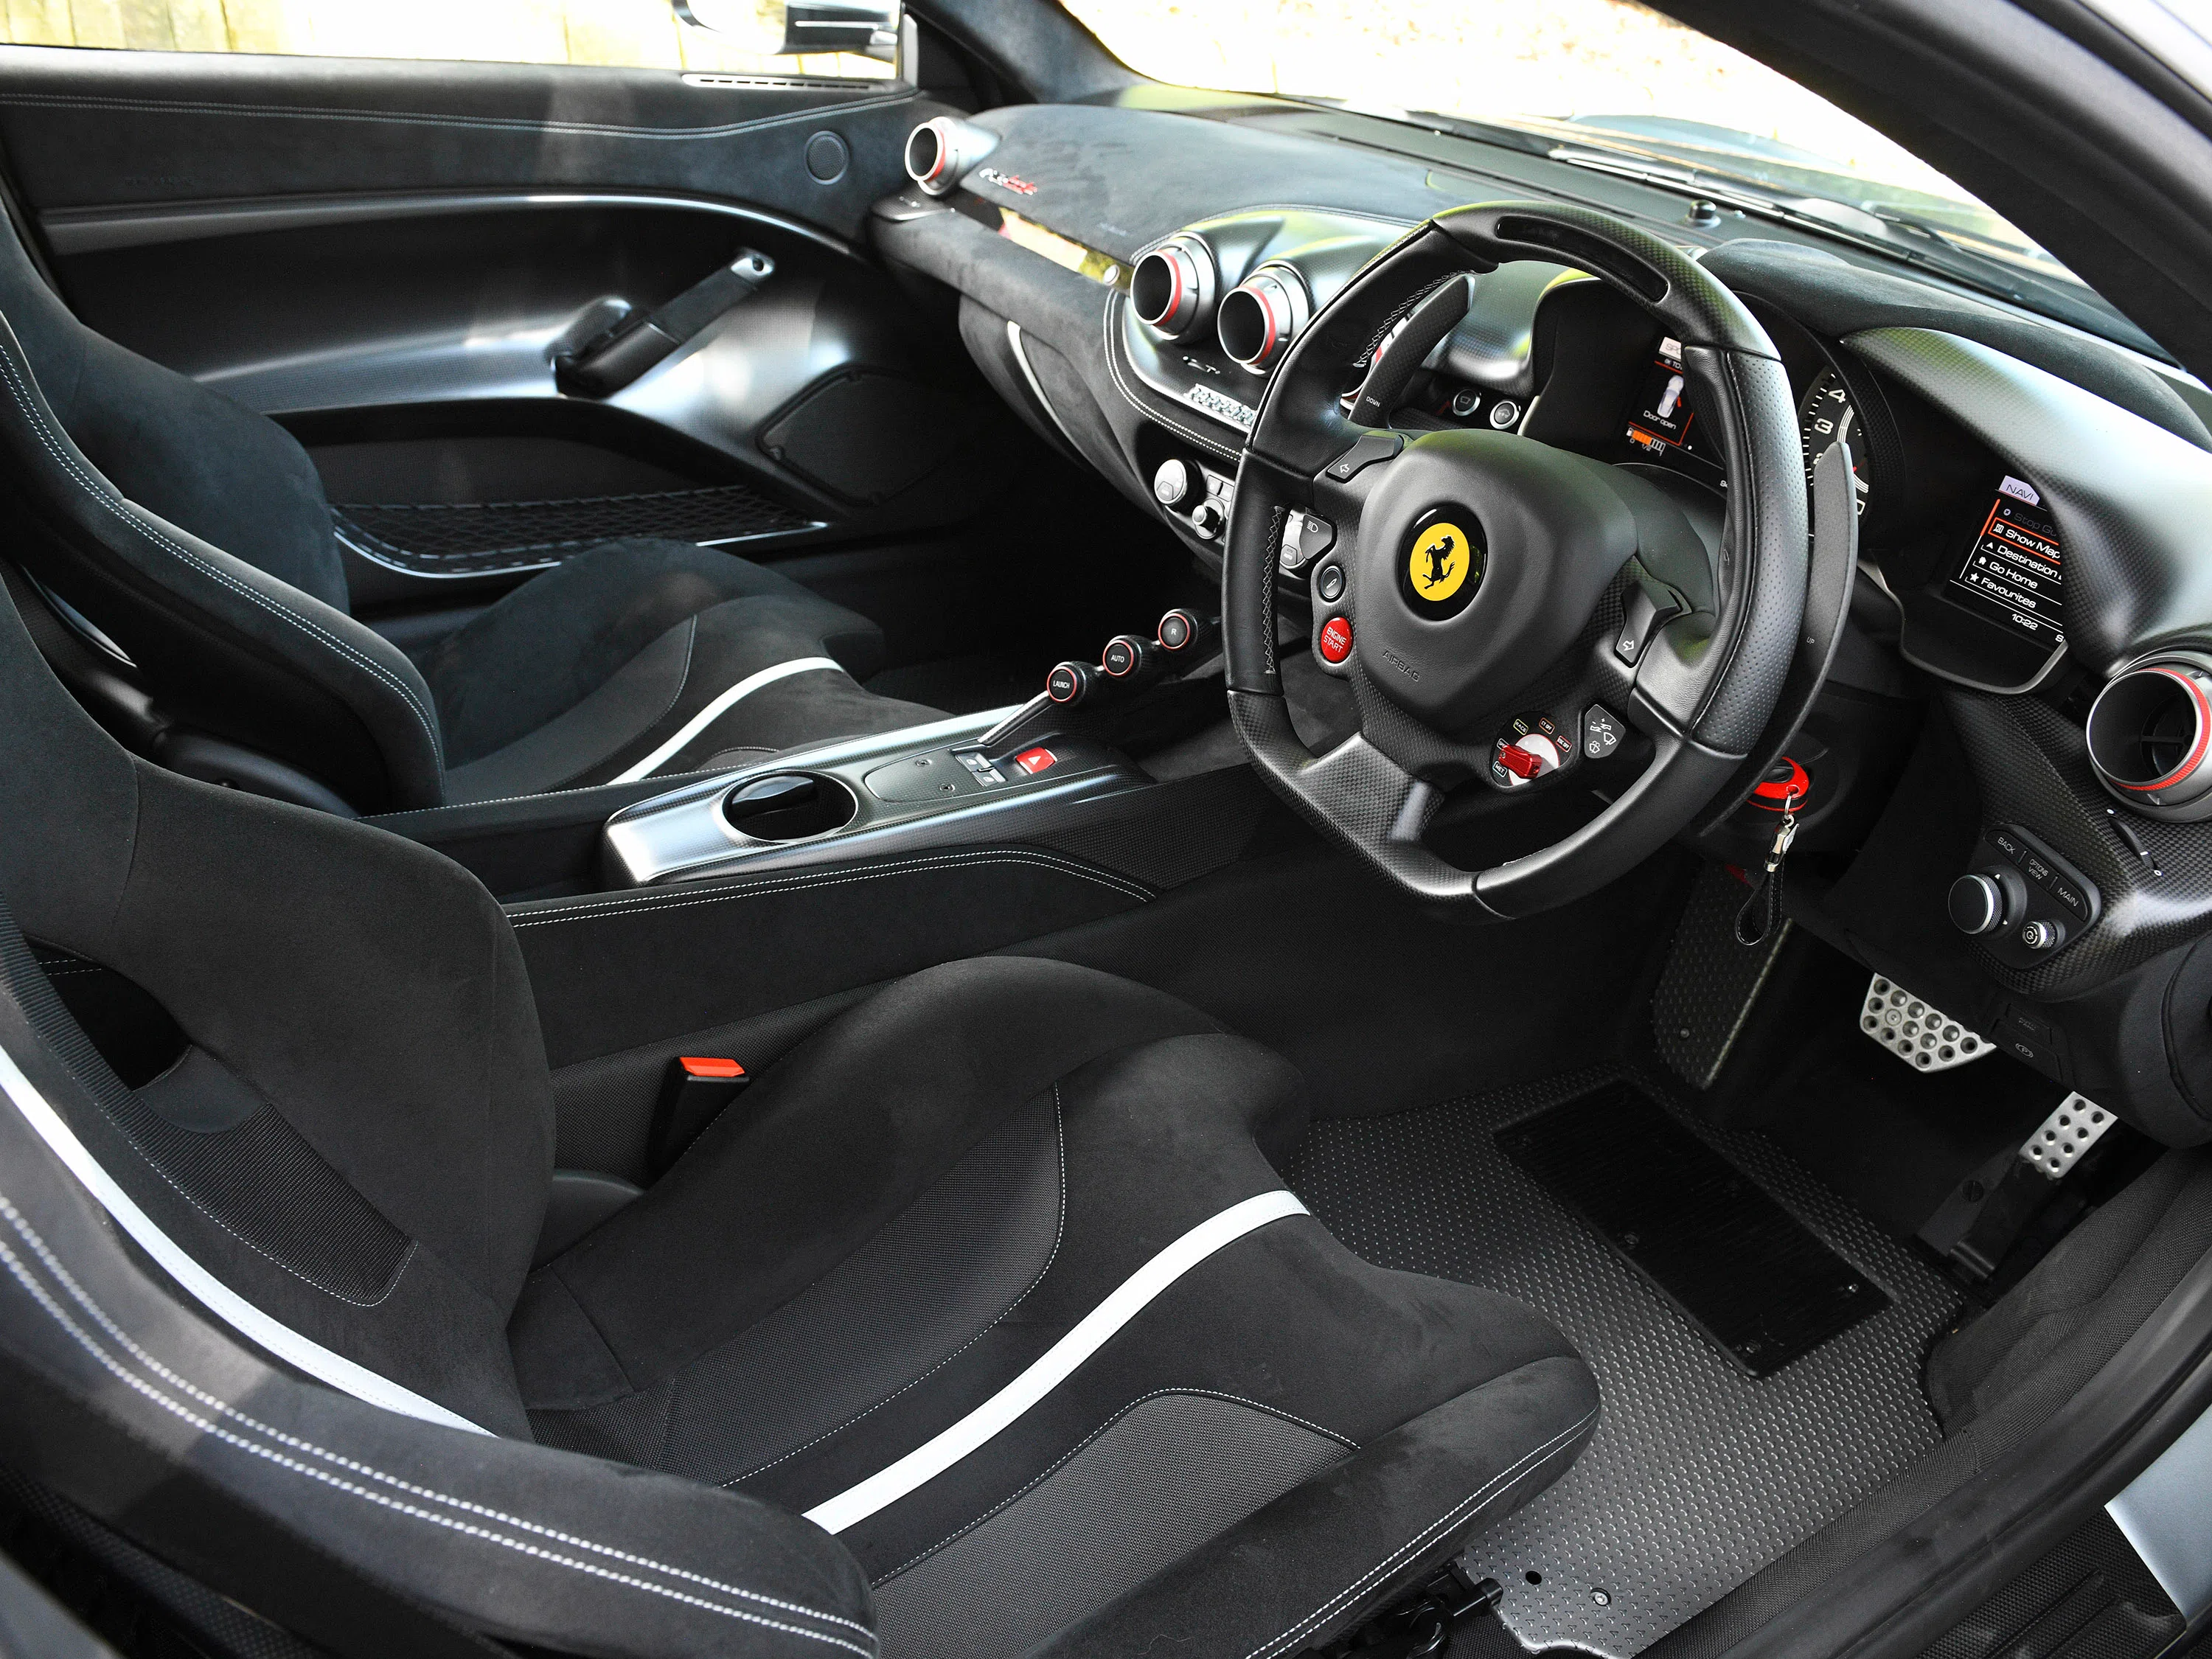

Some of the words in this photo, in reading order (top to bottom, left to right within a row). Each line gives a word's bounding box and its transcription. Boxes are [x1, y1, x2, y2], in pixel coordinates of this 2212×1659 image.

[1366, 395, 1380, 408] DOWN
[1828, 389, 1846, 403] 4
[1643, 410, 1660, 422] Door
[1660, 419, 1677, 430] open
[1815, 418, 1834, 434] 3
[2006, 483, 2034, 501] NAVI
[2014, 512, 2040, 530] Stop
[2006, 529, 2036, 548] Show
[2036, 542, 2061, 559] Map
[1997, 545, 2059, 579] Destination
[1989, 561, 2006, 574] Go
[2005, 568, 2038, 589] Home
[1980, 577, 2037, 609] Favourites
[2011, 613, 2039, 630] 10:22
[1323, 635, 1343, 653] START
[1326, 626, 1348, 646] ENGINE
[1110, 654, 1125, 663] AUTO
[1382, 650, 1421, 682] AIRBAG
[1053, 680, 1071, 689] LAUNCH
[1515, 721, 1527, 734] RACE
[1997, 836, 2016, 855] BACK
[2028, 858, 2049, 877] OPTIONS
[2028, 867, 2042, 880] VIEW
[2057, 887, 2079, 907] MAIN
